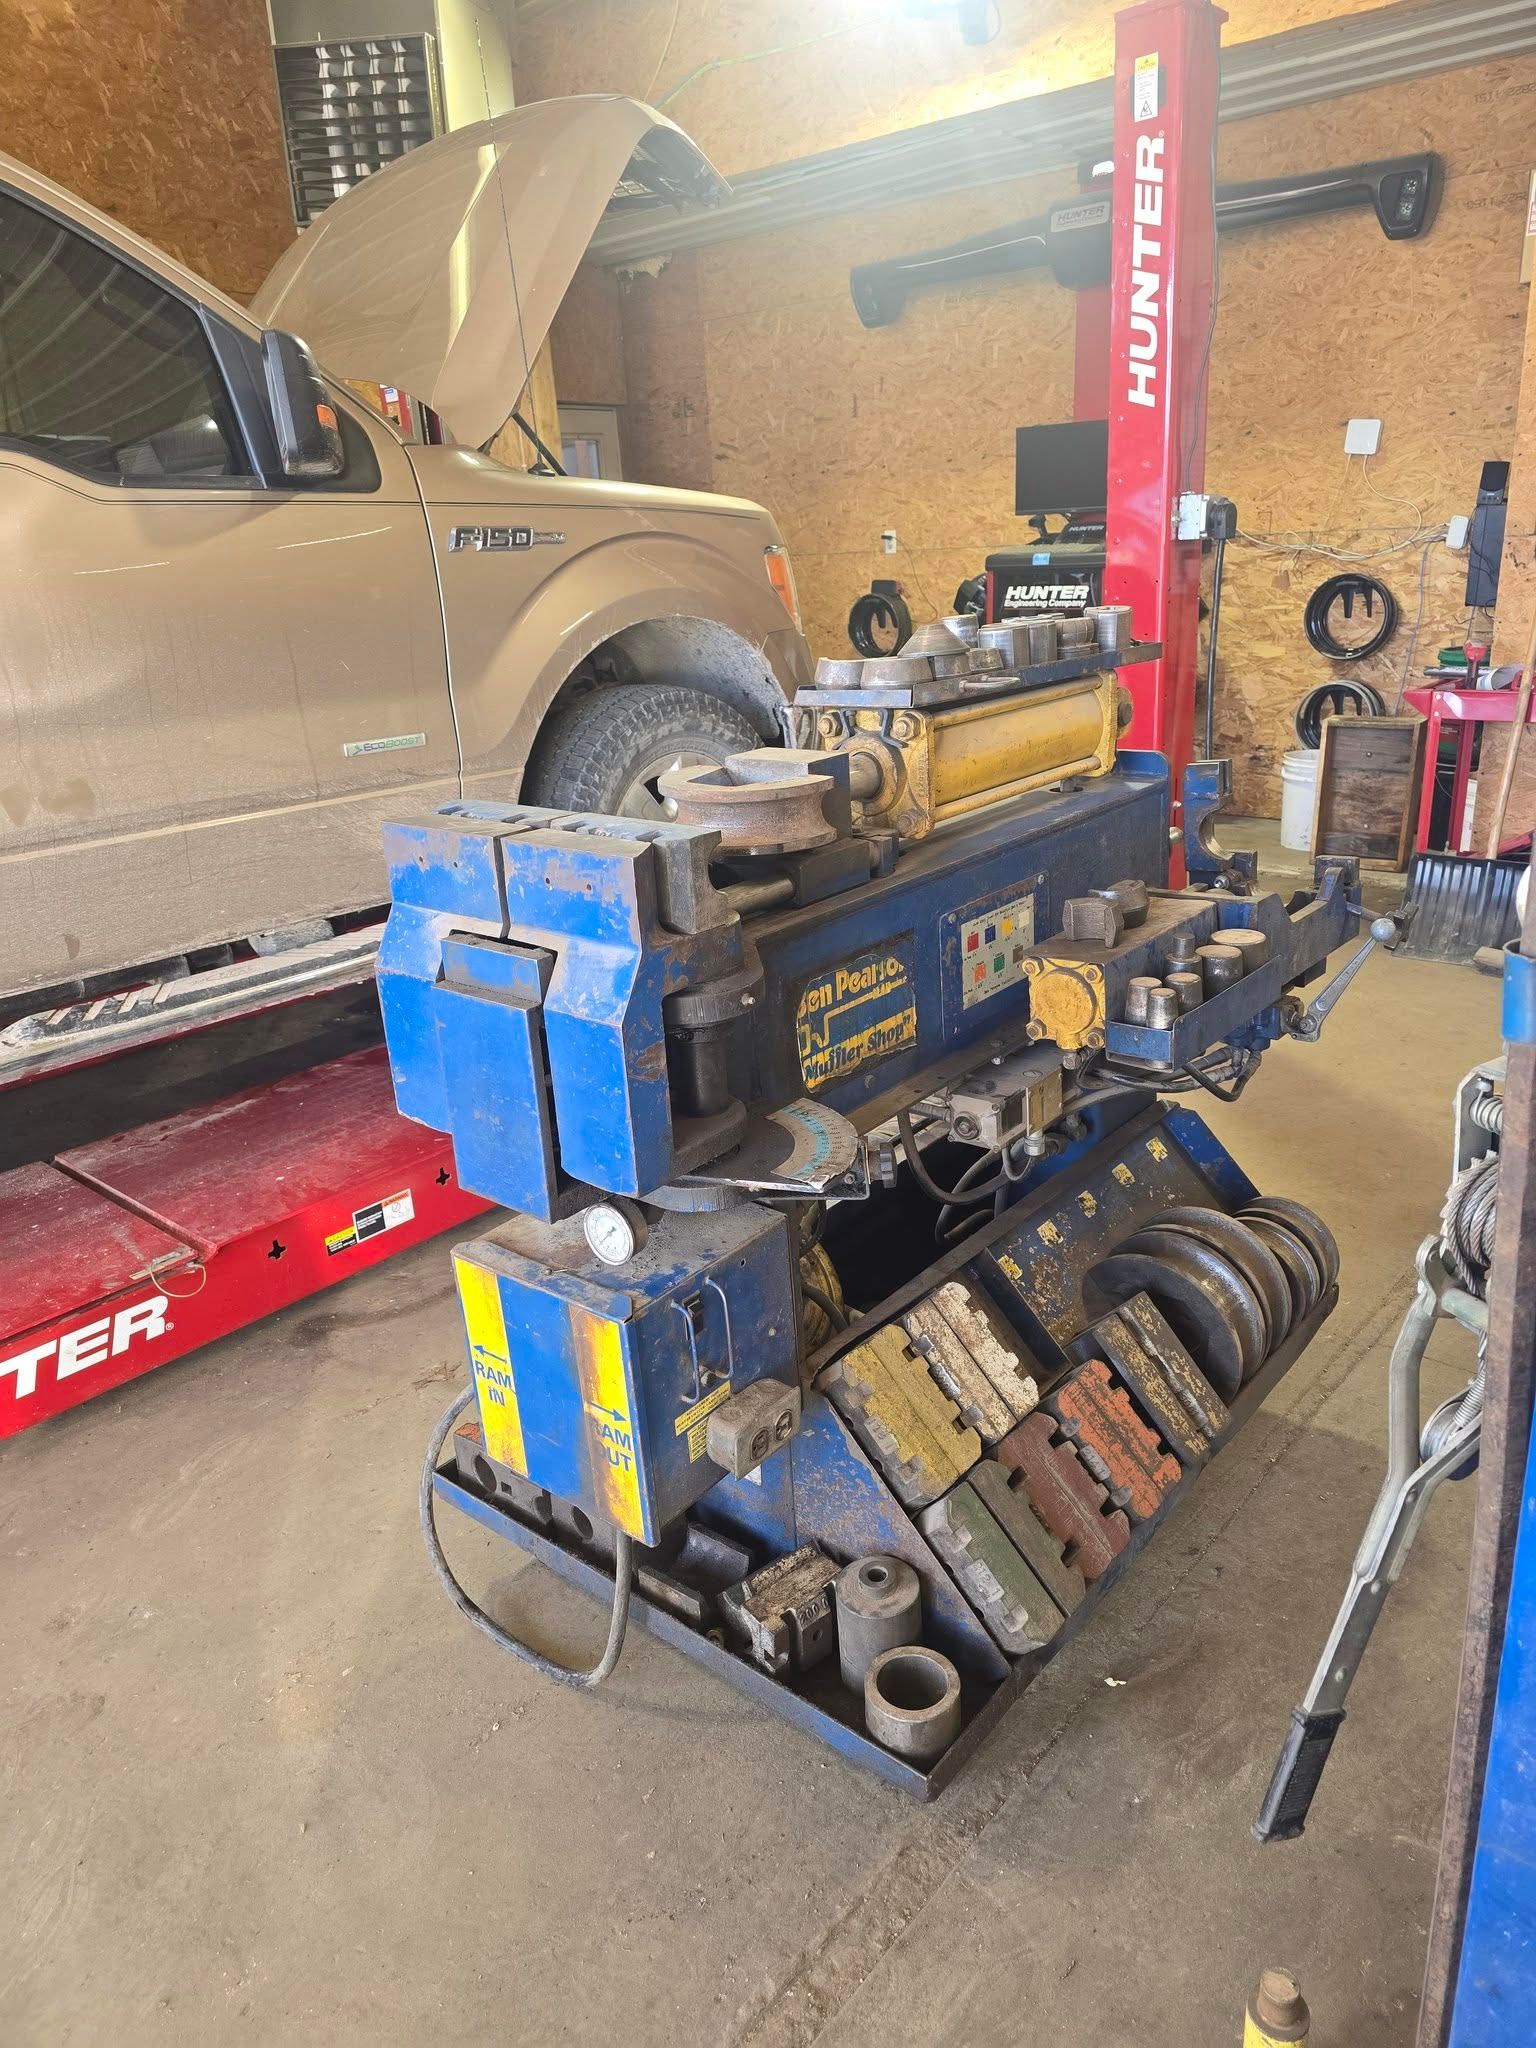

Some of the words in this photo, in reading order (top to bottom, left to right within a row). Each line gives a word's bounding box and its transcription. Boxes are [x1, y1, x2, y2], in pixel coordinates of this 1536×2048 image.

[1005, 585, 1090, 600] HUNTER
[1004, 599, 1048, 609] Engineering
[1048, 599, 1087, 609] Company
[474, 1360, 512, 1389] RAM
[488, 1385, 506, 1407] IN
